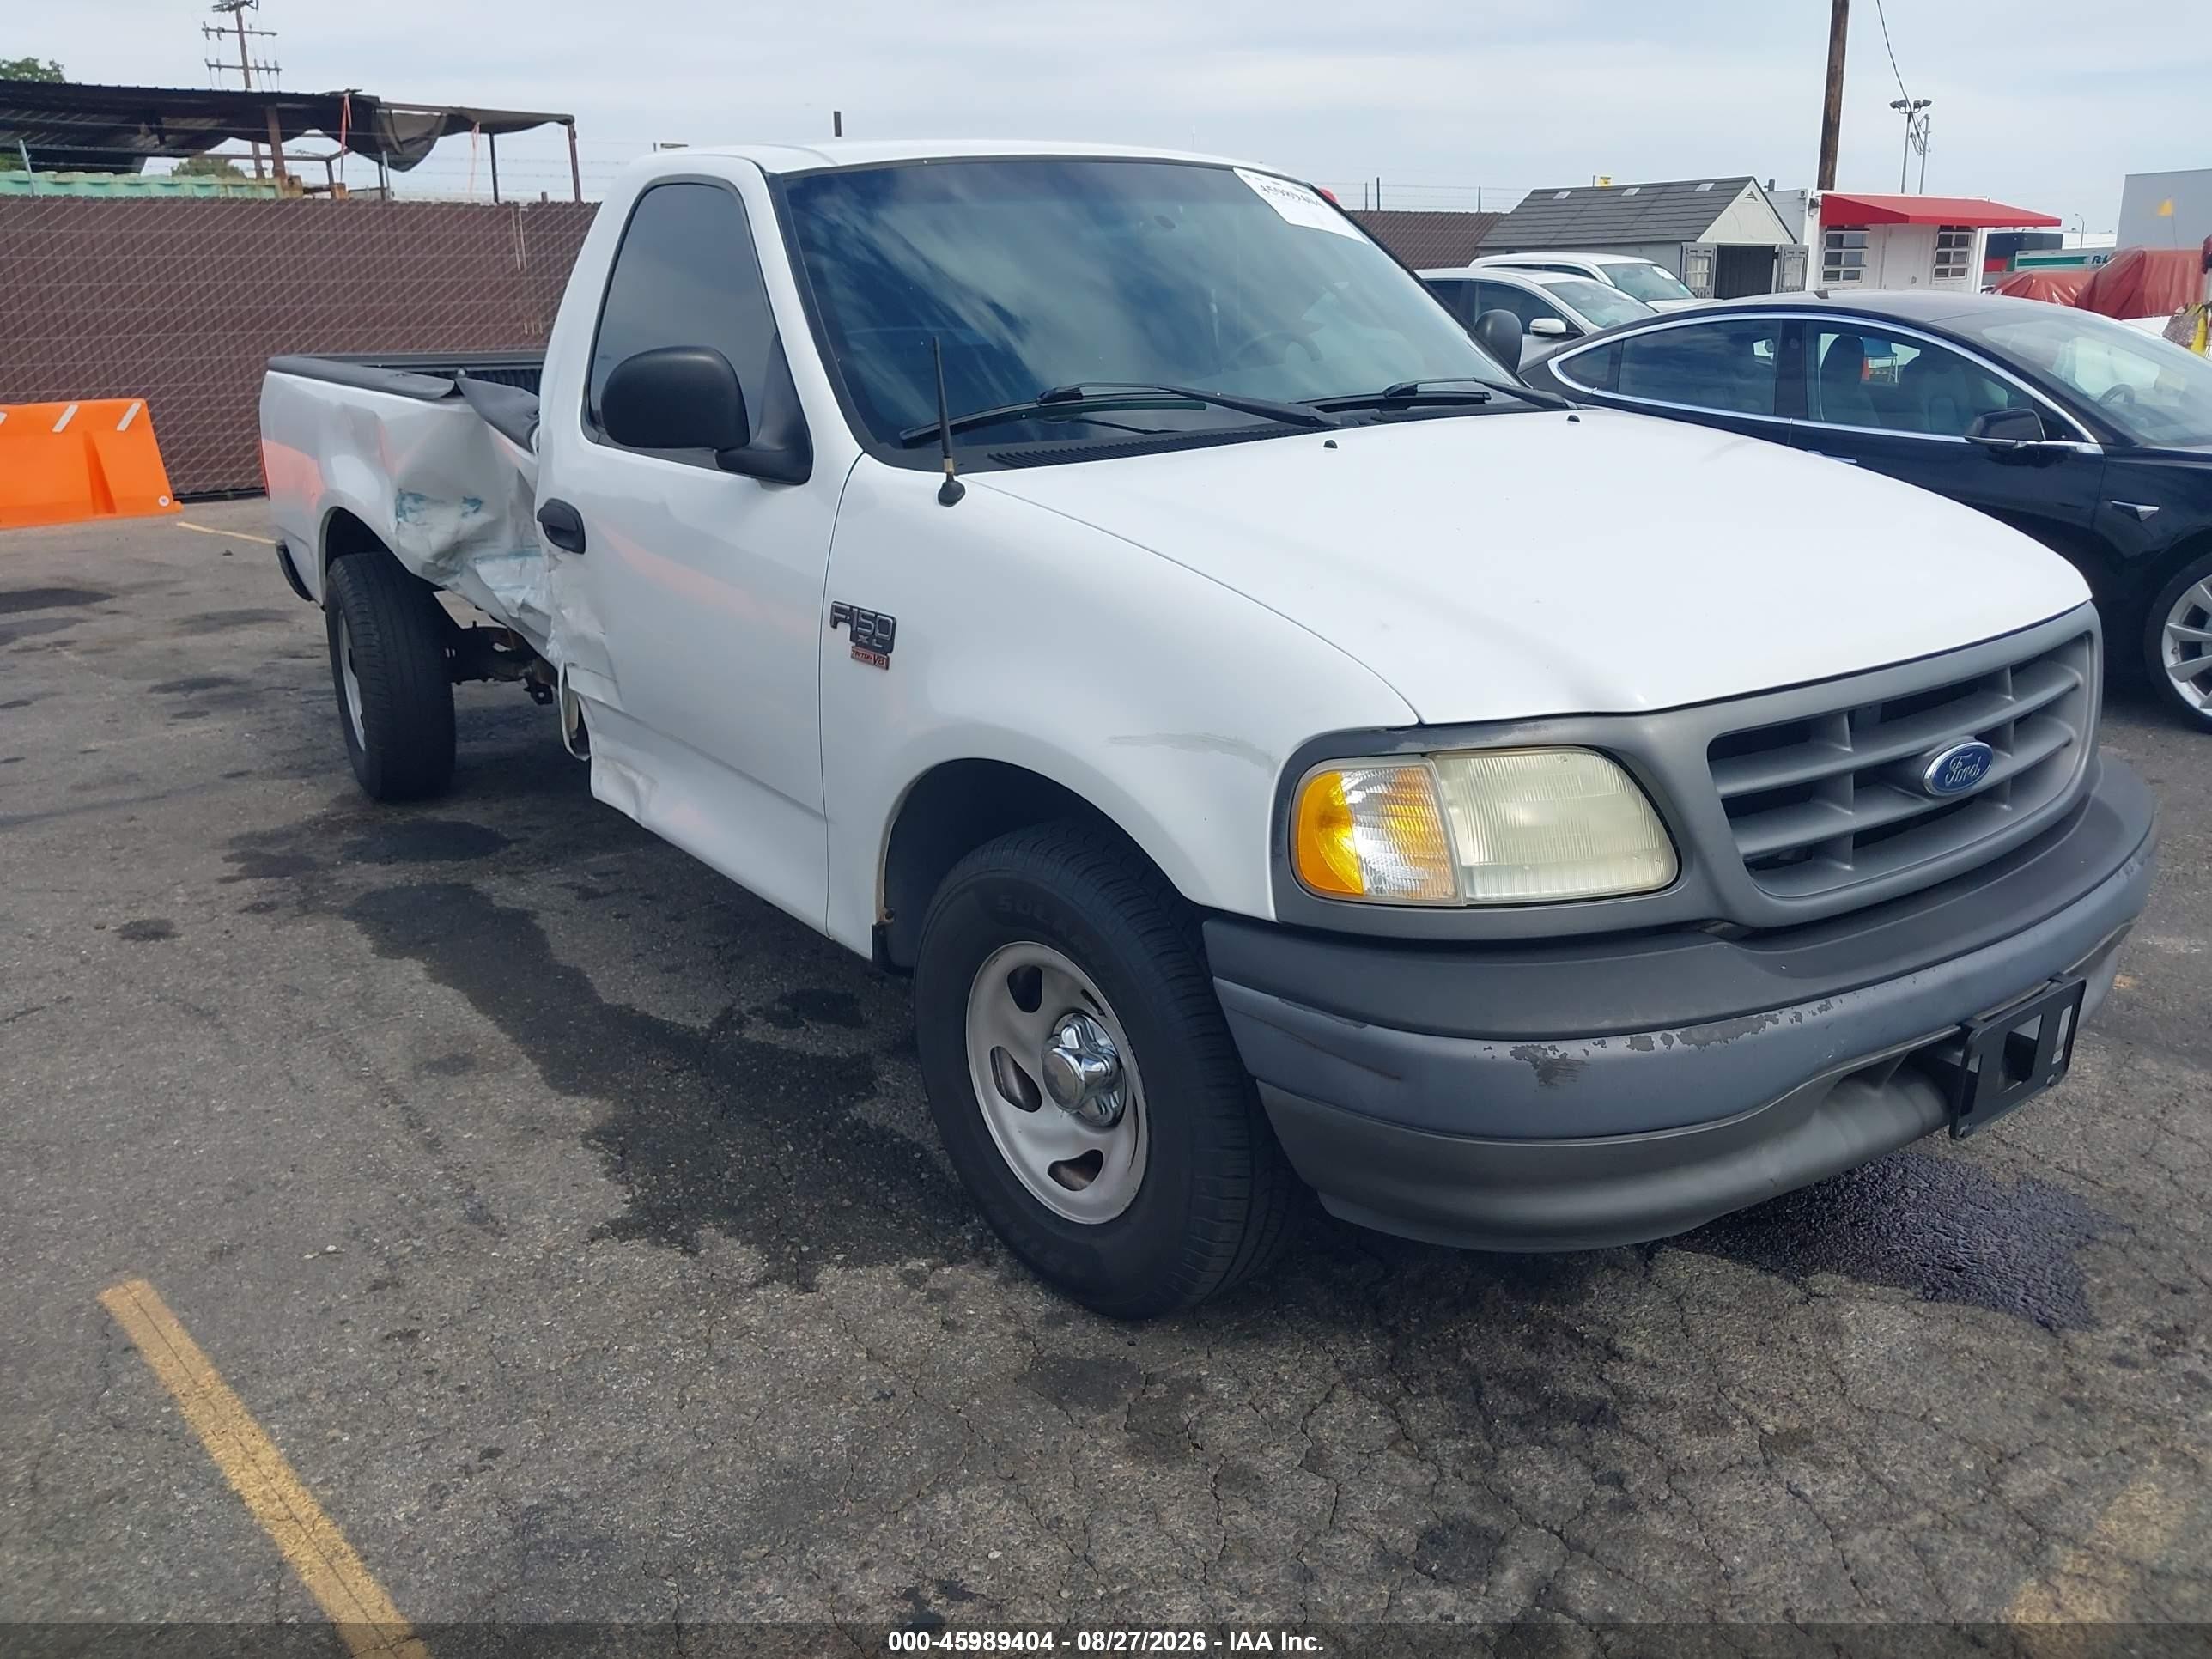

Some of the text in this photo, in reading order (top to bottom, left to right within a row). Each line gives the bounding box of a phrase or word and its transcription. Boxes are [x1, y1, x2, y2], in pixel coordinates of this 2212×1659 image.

[857, 634, 883, 648] XL
[851, 649, 886, 665] TRITON V8
[1945, 752, 1982, 787] Ford
